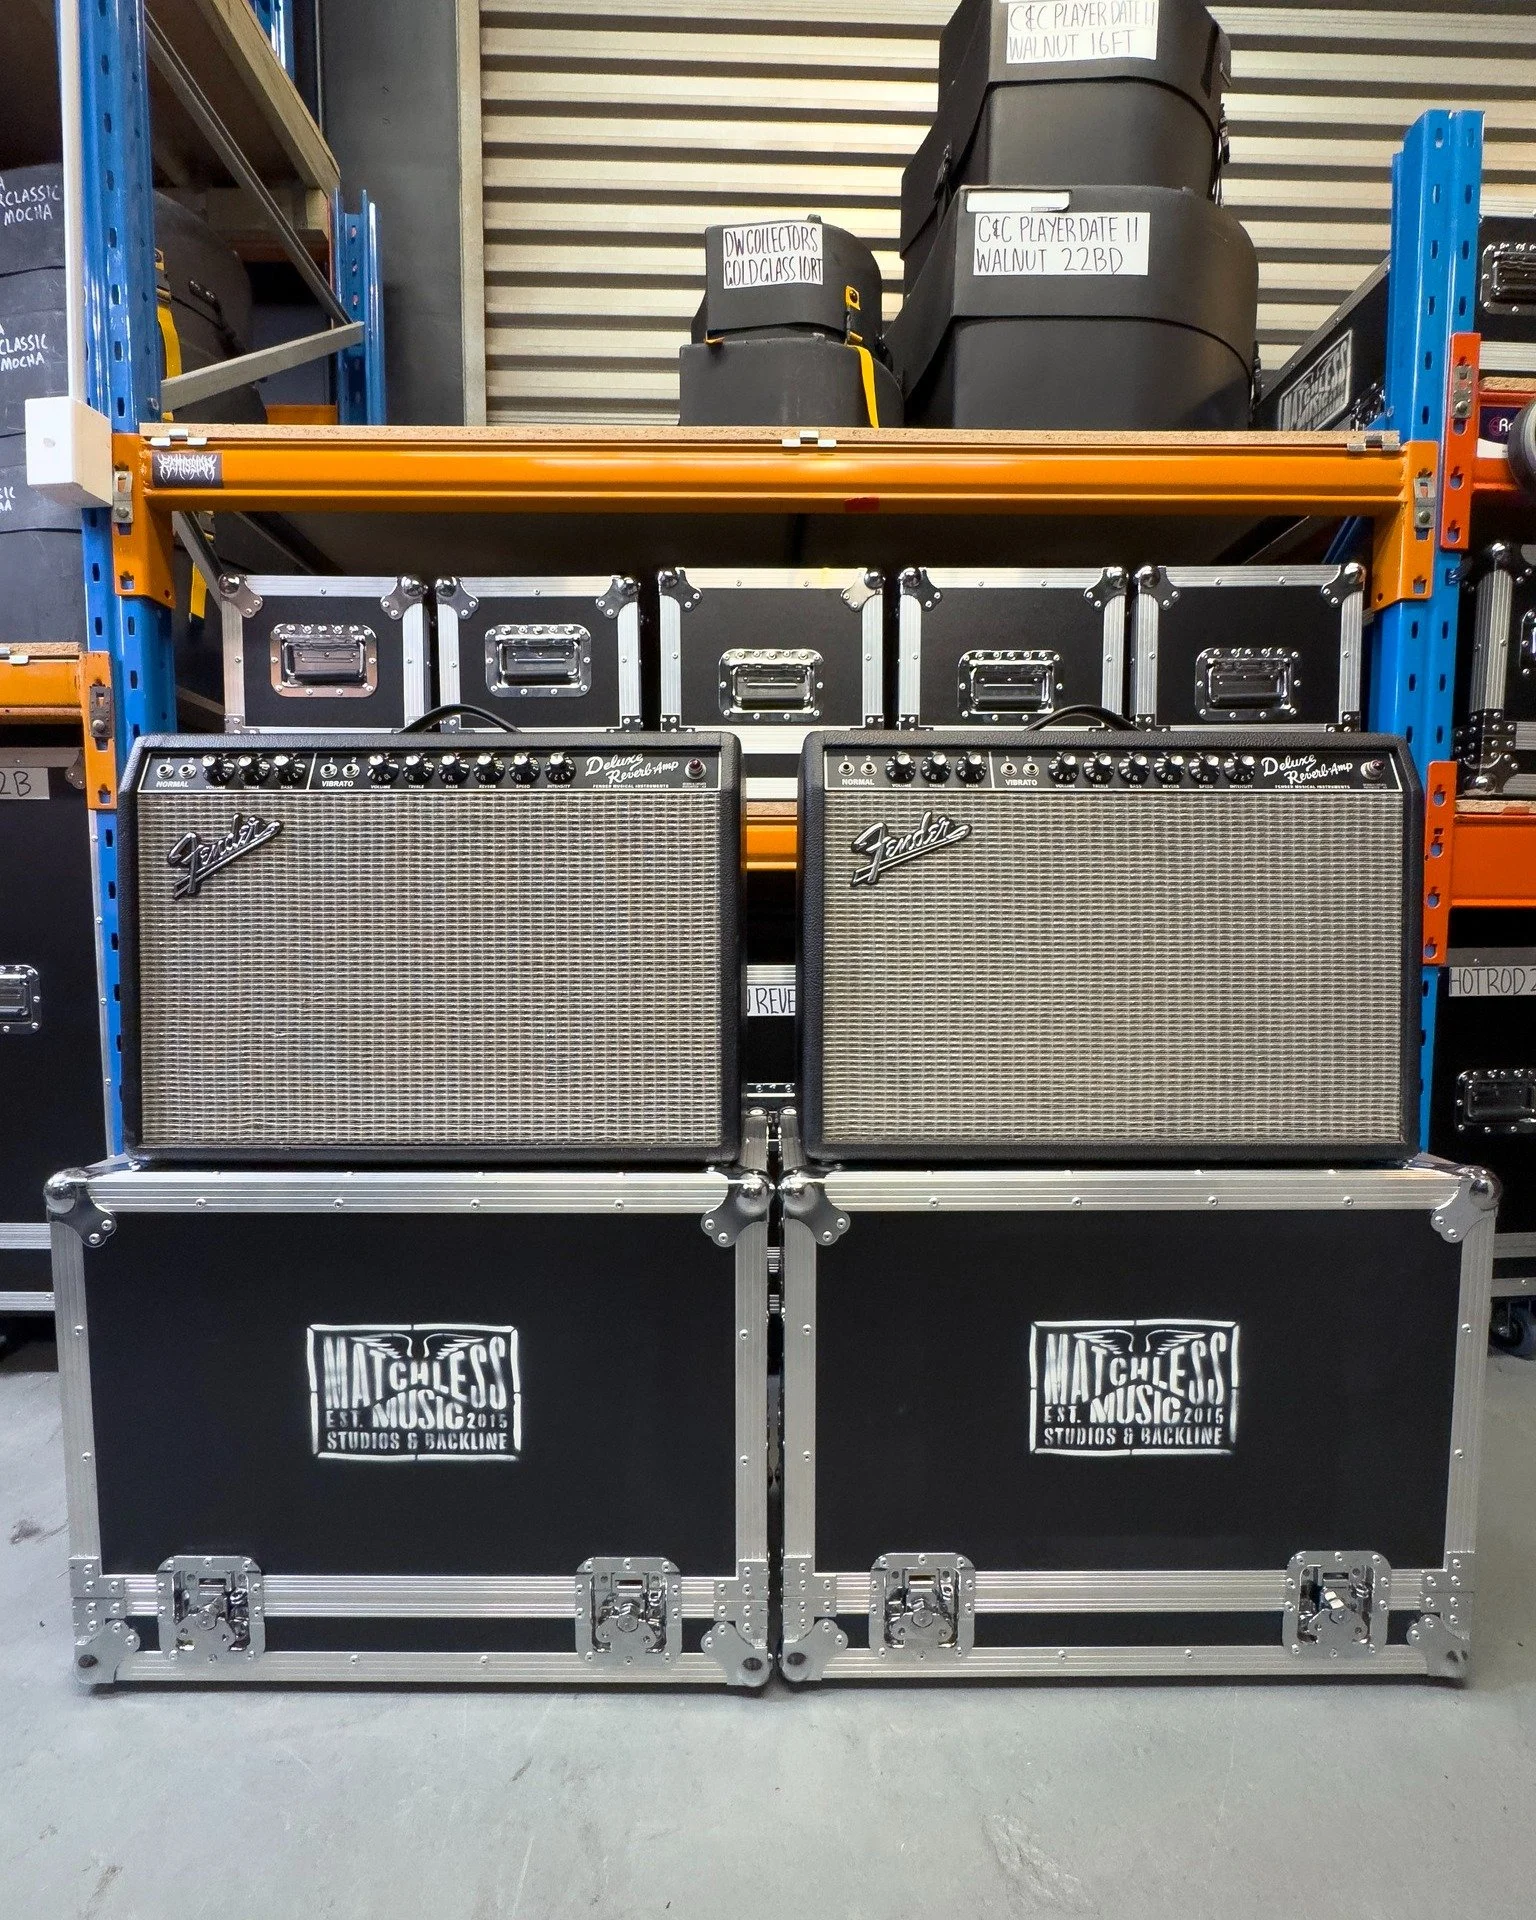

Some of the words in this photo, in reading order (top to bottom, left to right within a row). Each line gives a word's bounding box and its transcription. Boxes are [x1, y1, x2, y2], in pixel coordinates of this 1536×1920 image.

[1010, 4, 1049, 31] C&C
[1009, 33, 1080, 60] WALNUT
[1092, 29, 1136, 56] 16FT
[4, 203, 53, 226] MOCHA
[978, 215, 1012, 243] C&C
[976, 248, 1047, 273] WALNUT
[1061, 247, 1124, 275] 22BD
[1, 351, 45, 371] MOCHA
[585, 753, 644, 777] Deluxe
[1261, 754, 1317, 777] Deluxe
[156, 780, 189, 788] NORMAL
[842, 778, 875, 786] NORMAL
[167, 813, 284, 899] Fender
[850, 810, 973, 887] Fender
[323, 1335, 507, 1410] MATCHLESS
[1044, 1331, 1227, 1405] MATCHLESS
[325, 1410, 363, 1428] EST.
[372, 1389, 464, 1430] MUSIC
[466, 1412, 508, 1429] 2015
[1044, 1405, 1082, 1423] EST.
[1090, 1384, 1181, 1424] MUSIC
[1184, 1407, 1224, 1424] 2015
[327, 1431, 400, 1450] STUDIOS
[425, 1432, 508, 1450] BACKLINE
[1044, 1427, 1117, 1445] STUDIOS
[1141, 1427, 1222, 1445] BACKLINE
